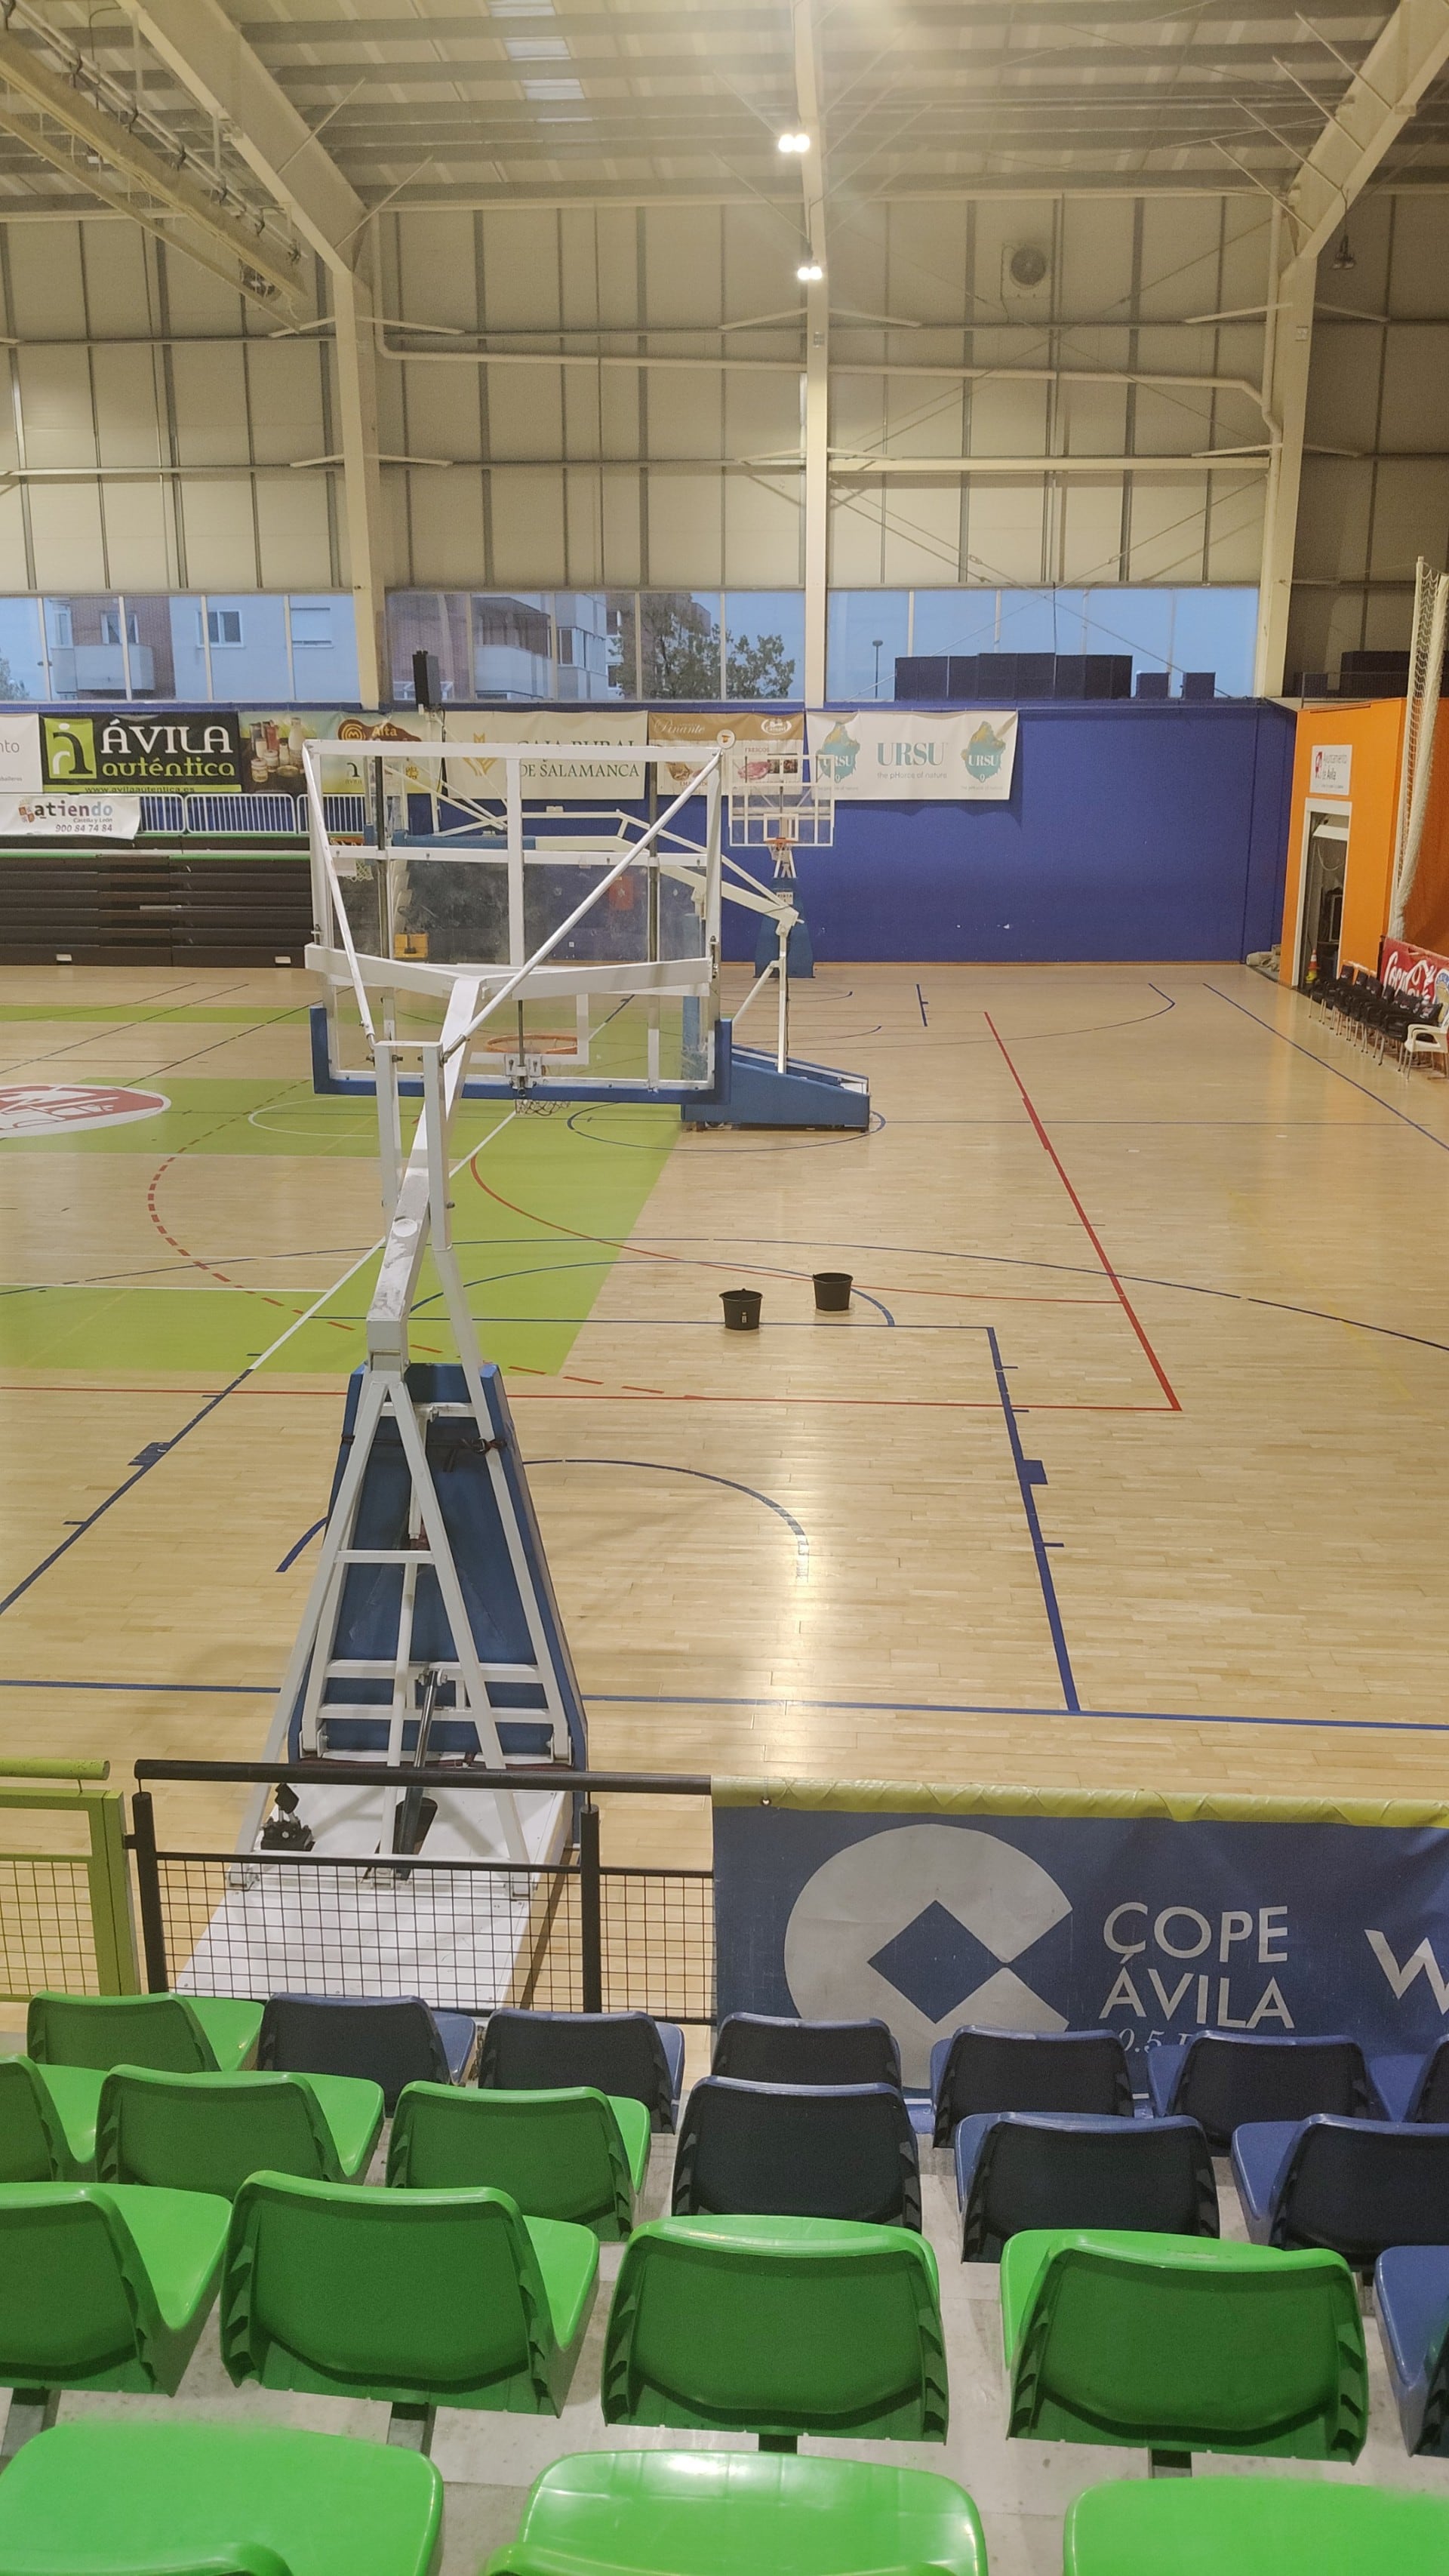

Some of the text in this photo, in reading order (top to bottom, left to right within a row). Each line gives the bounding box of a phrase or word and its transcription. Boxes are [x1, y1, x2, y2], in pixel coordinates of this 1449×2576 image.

[100, 719, 233, 754] ÁVILA
[877, 742, 944, 766] URSU
[968, 754, 998, 767] URSU
[102, 757, 235, 777] auténtica
[540, 764, 640, 777] SALAMANCA
[35, 800, 112, 817] atiendo
[1103, 1901, 1287, 1963] COPE
[1098, 1953, 1295, 2029] ÁVILA
